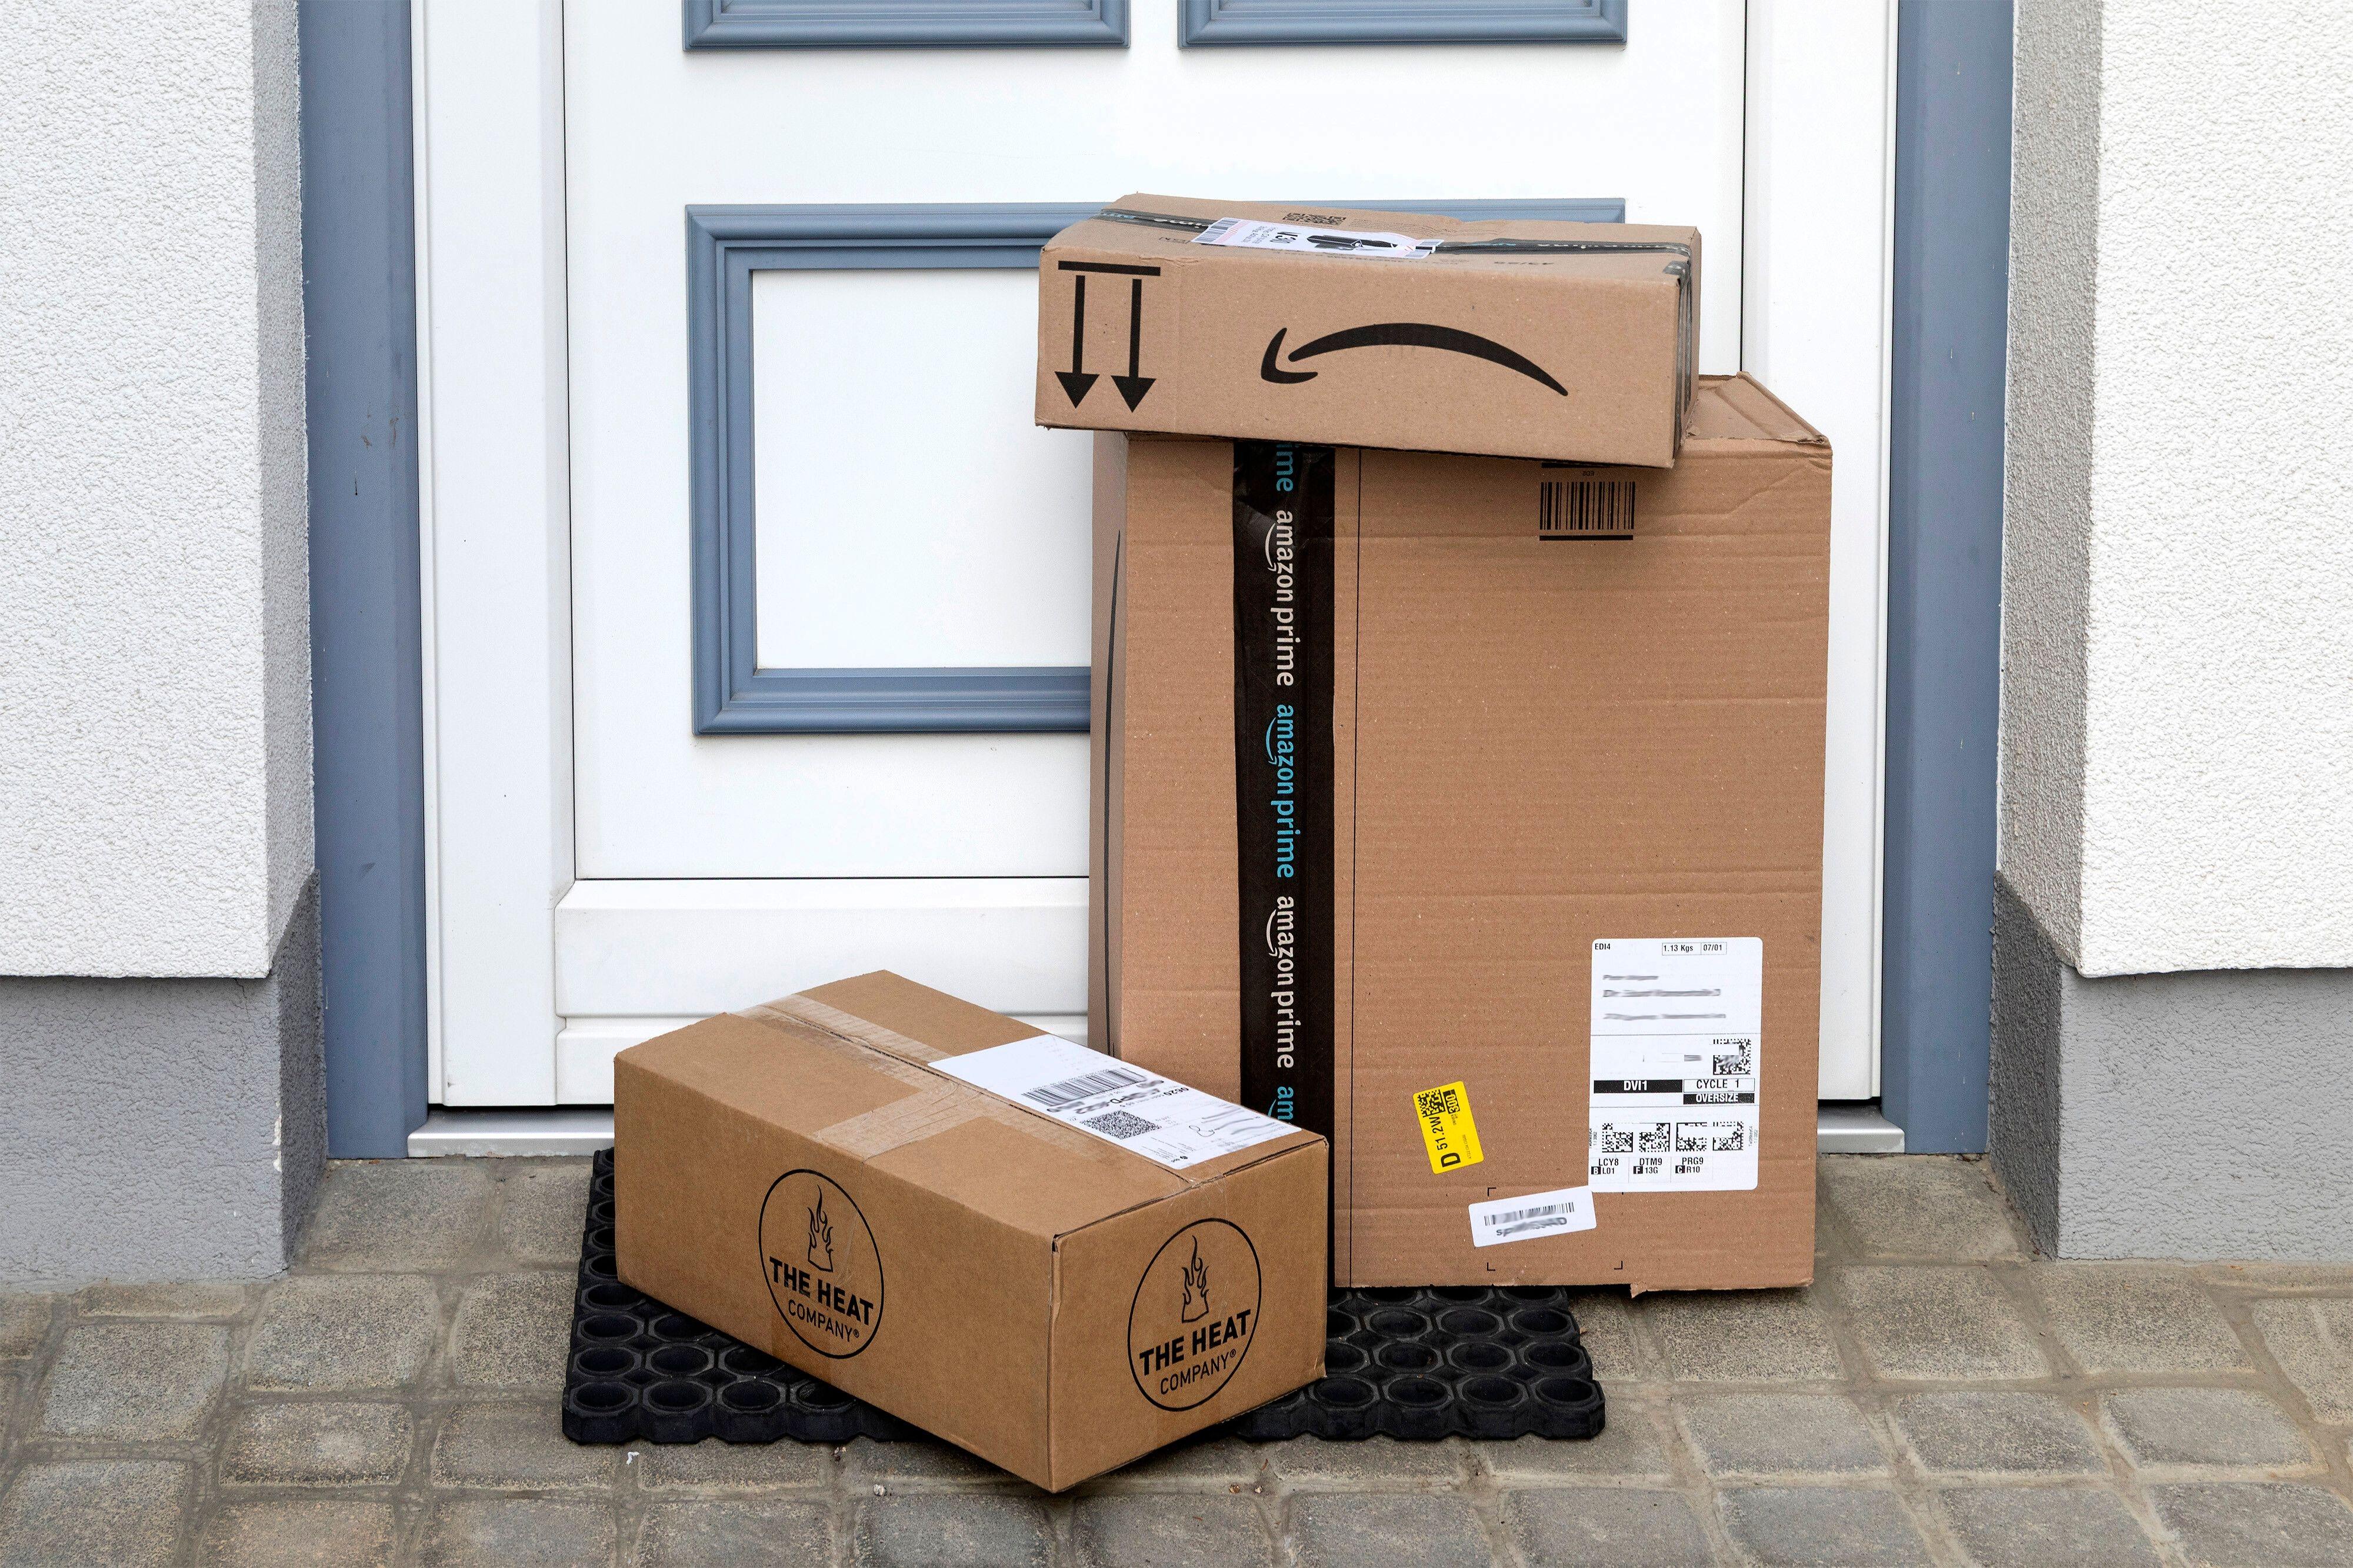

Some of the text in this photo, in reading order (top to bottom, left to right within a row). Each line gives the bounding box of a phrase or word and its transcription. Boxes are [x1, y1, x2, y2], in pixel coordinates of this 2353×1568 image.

[1276, 443, 1299, 492] ime
[1271, 510, 1301, 686] amazon prime
[1271, 705, 1301, 878] amazon prime
[1277, 896, 1294, 986] amazon
[1681, 945, 1694, 953] Kgs
[1271, 991, 1301, 1068] prime
[1445, 1093, 1460, 1114] 300
[1624, 1080, 1647, 1091] DVI1
[1695, 1093, 1738, 1103] OVERSIZE
[1428, 1116, 1461, 1167] D 51.2W
[1598, 1158, 1619, 1166] LCY8
[1639, 1157, 1662, 1166] DTM9
[1682, 1157, 1704, 1165] PRG9
[769, 1256, 874, 1326] THE HEAT
[1139, 1308, 1251, 1376] THE HEAT
